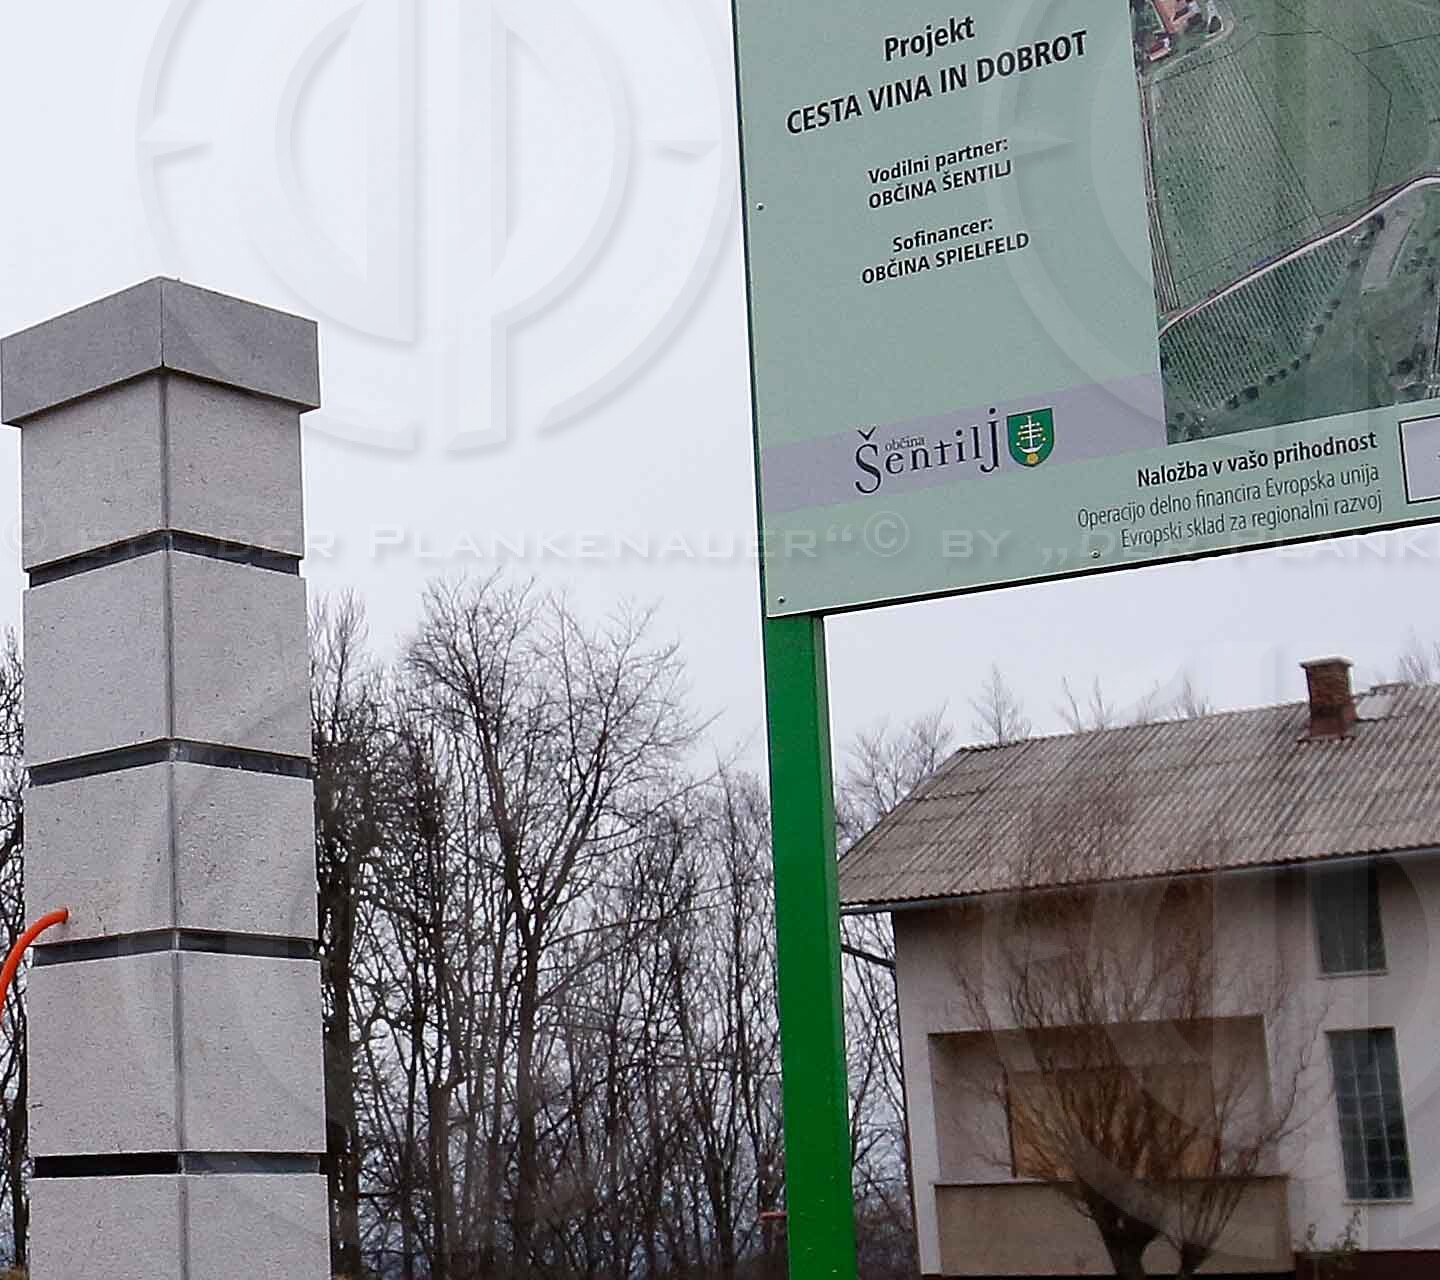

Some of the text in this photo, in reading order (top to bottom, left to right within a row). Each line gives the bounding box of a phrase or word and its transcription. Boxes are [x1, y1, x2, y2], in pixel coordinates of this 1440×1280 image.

[885, 16, 975, 61] Projekt
[787, 30, 1087, 133] CESTA VINA IN DOBROT
[868, 139, 1008, 183] Vodilni partner:
[869, 160, 1011, 208] OBČINA ŠENTILJ
[862, 233, 1029, 283] OBČINA SPIELFELD
[893, 218, 992, 252] Sofinancer:
[855, 407, 1000, 494] Šentilj
[1138, 432, 1378, 487] Naložba v vašo prihodnost
[1078, 464, 1379, 529] Operacijo delno financira Evropska unija
[1121, 490, 1382, 548] Evropski sklad za regionalni razvoj
